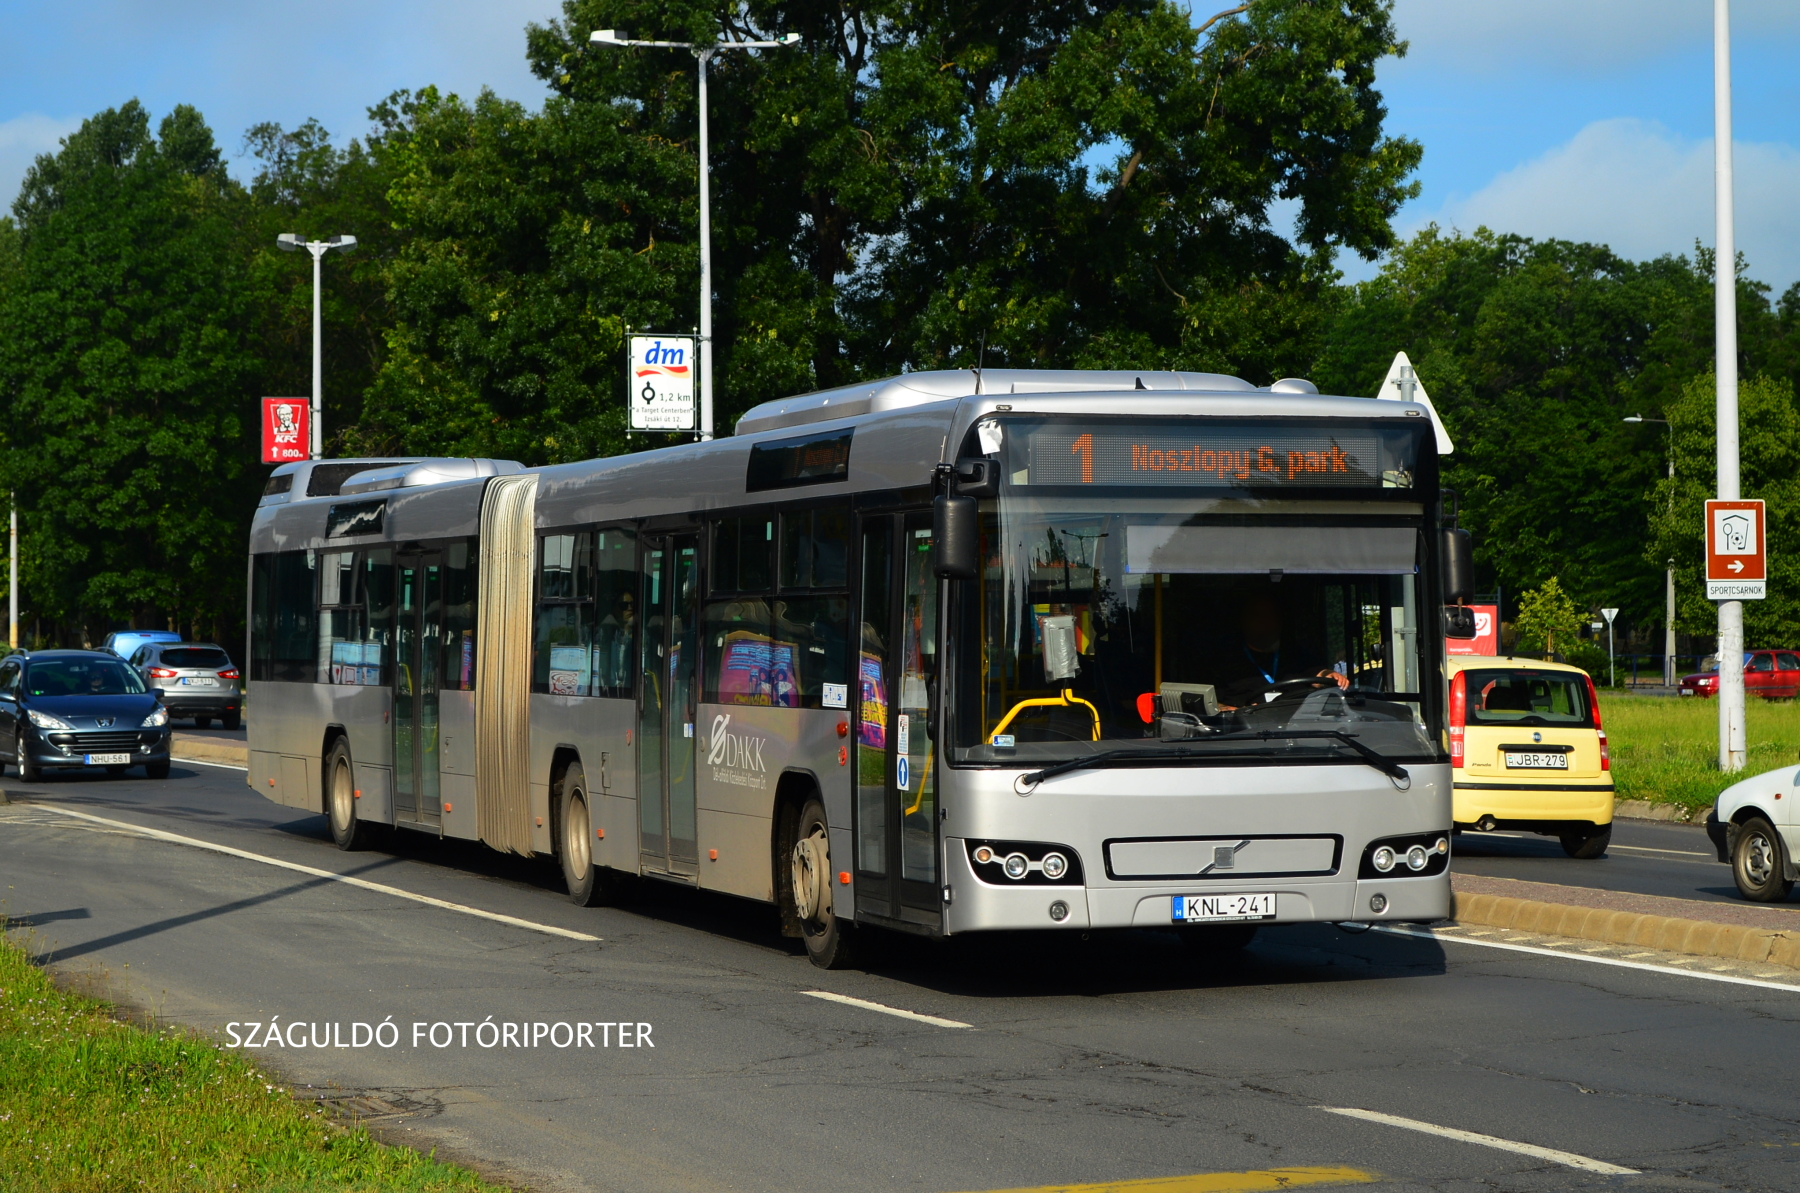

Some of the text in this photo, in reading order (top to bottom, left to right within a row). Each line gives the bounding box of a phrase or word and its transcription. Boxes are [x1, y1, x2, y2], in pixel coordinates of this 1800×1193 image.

[645, 341, 684, 364] dm
[660, 393, 691, 402] 1,2 km
[274, 435, 298, 443] KFC
[1071, 434, 1347, 483] 1 Noszlopy G. park
[1710, 586, 1763, 595] SPORTCSARNOK
[727, 733, 766, 772] DAKK
[91, 755, 128, 763] NHU-561
[1516, 755, 1566, 766] JBR-279
[1188, 896, 1269, 916] KNL-241
